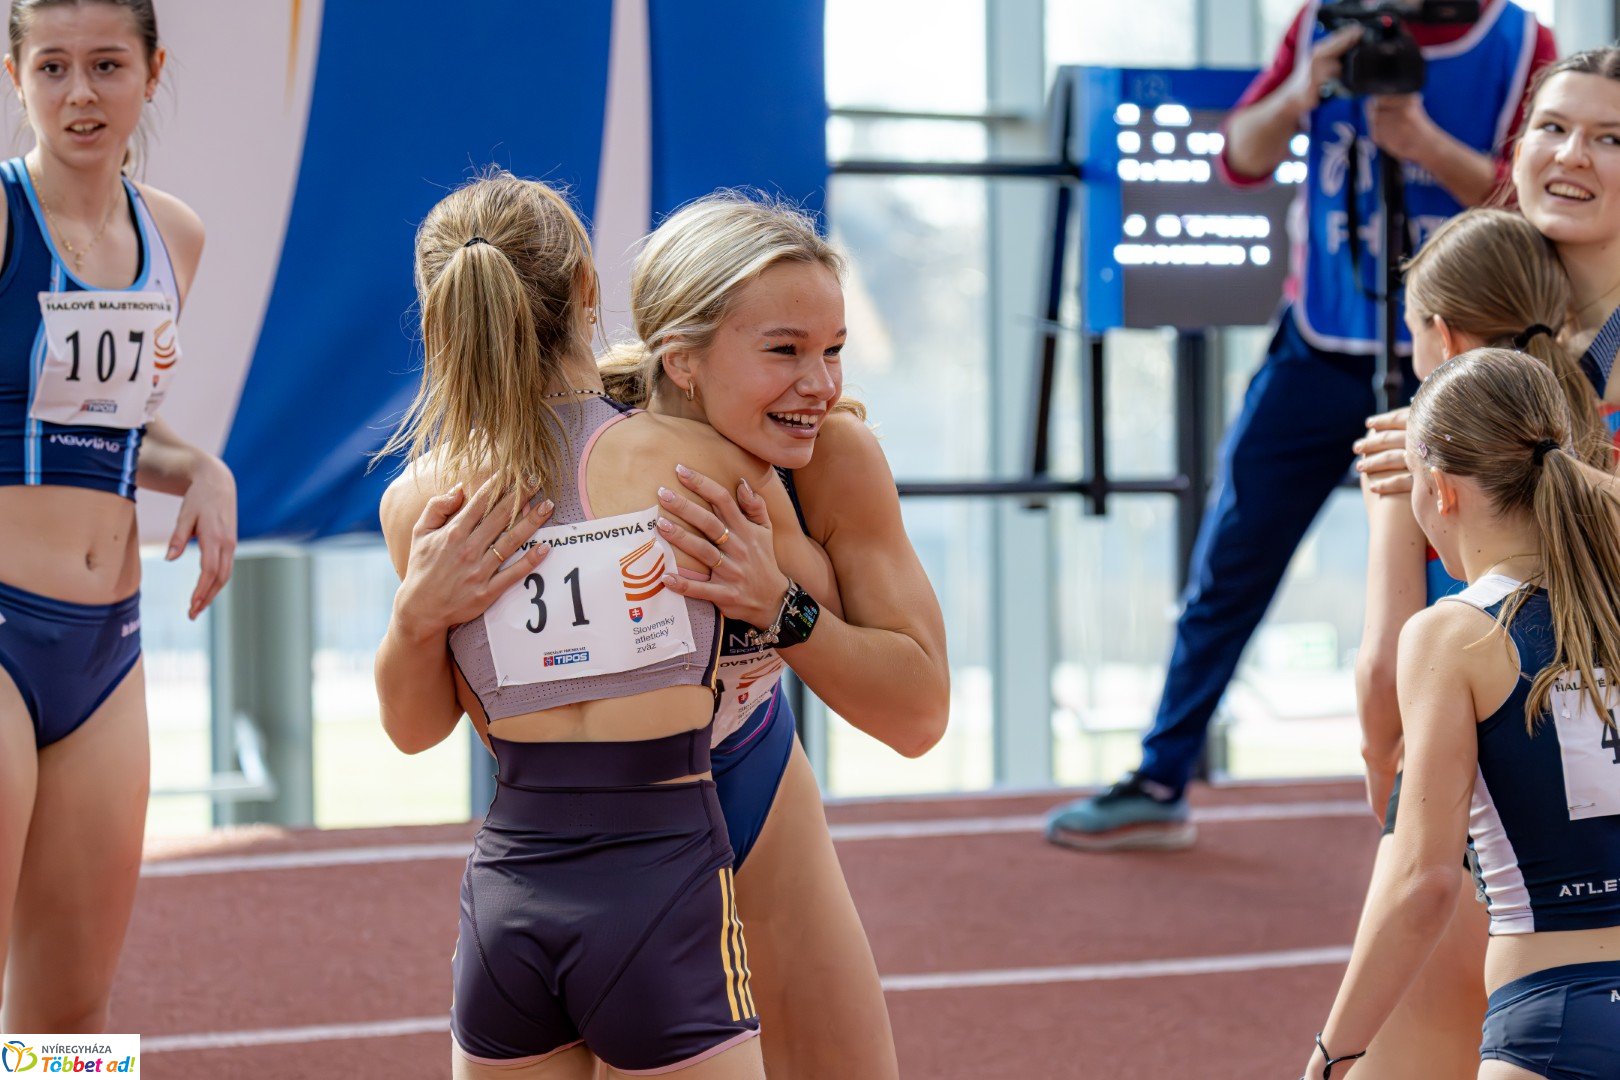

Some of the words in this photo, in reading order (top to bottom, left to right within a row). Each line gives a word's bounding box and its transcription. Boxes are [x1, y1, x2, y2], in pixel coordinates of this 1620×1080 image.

[46, 301, 95, 310] HALOVÉ
[65, 329, 144, 382] 107
[523, 567, 590, 634] 31
[632, 615, 675, 635] Slovenský
[635, 627, 669, 644] atletický
[637, 643, 656, 653] zväz
[555, 652, 588, 664] TIPOS
[1555, 678, 1606, 692] HALÉ
[1559, 878, 1620, 897] ATLE
